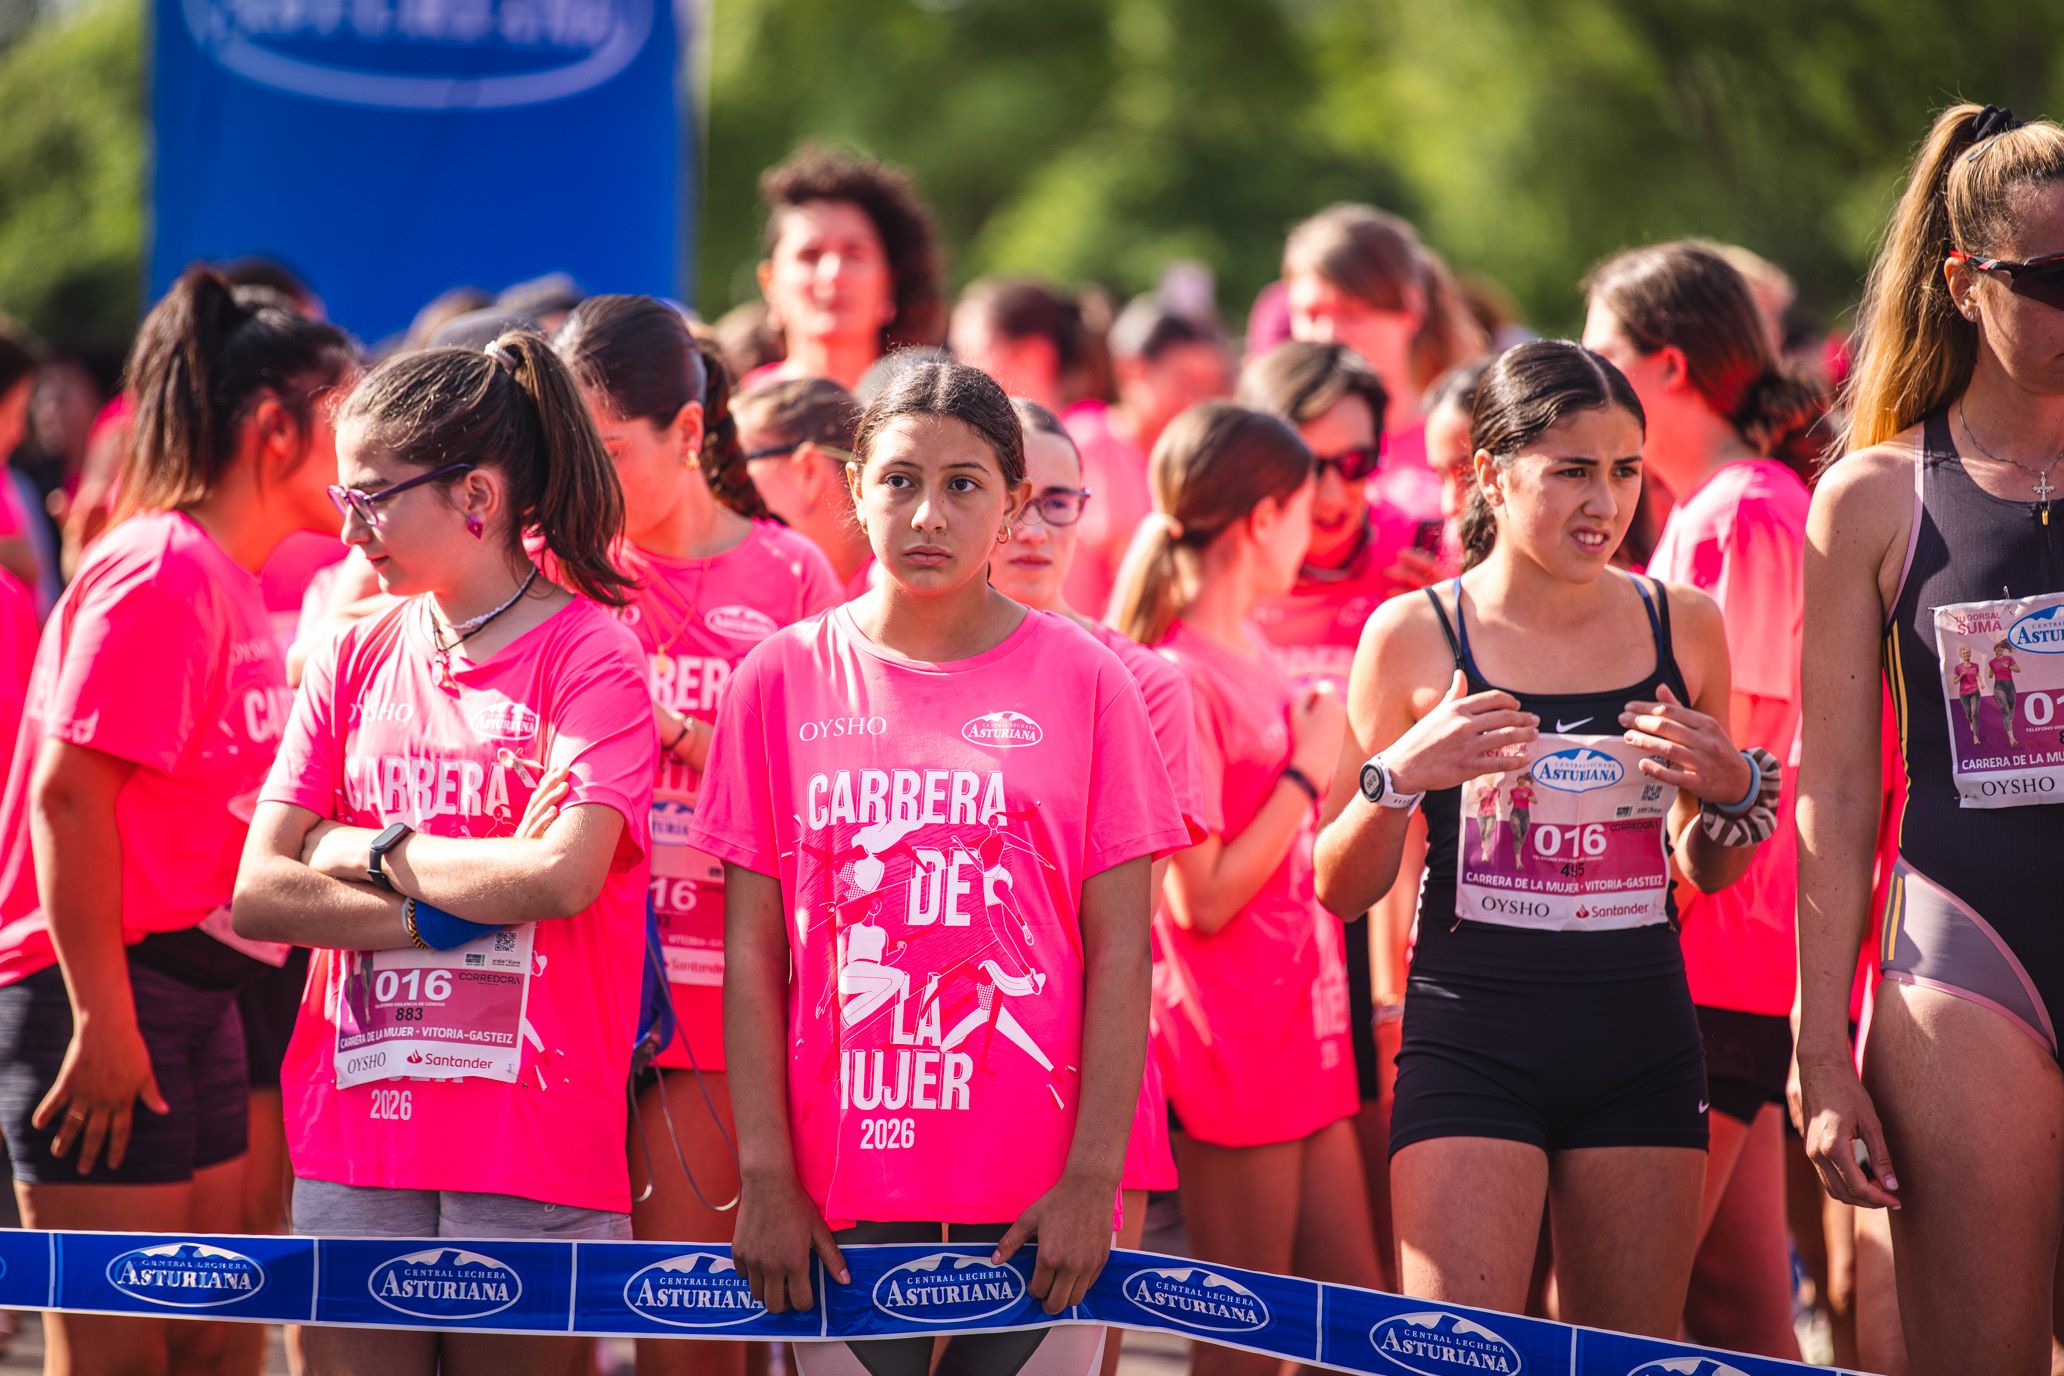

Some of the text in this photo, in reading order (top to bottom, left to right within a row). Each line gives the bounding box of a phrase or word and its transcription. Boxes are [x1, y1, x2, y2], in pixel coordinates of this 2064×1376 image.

[1967, 612, 2000, 621] DORSAL
[2032, 621, 2064, 629] CENTRA
[1957, 622, 2002, 635] SUMA
[2017, 626, 2064, 645] ASTU
[799, 716, 887, 741] OYSHO
[967, 723, 1036, 742] ASTURIANA
[1961, 752, 2064, 770] CARRERA DE LA MU
[345, 756, 511, 818] CARRERA
[1981, 776, 2055, 797] OYSHO
[807, 769, 1008, 831] CARRERA
[1534, 823, 1607, 858] 016
[1560, 863, 1585, 878] 495
[904, 846, 978, 926] DE
[1466, 872, 1663, 893] CARRERA DE LA MUJER VITORIA-GASTEIZ
[649, 877, 697, 911] 16
[1482, 895, 1550, 918] OYSHO
[1592, 903, 1650, 919] Santander
[374, 969, 453, 1003] 016
[459, 972, 521, 985] CORREDORA
[395, 1008, 423, 1021] 883
[891, 971, 942, 1047] LA
[340, 1027, 514, 1049] CARRERA DE LA MUJER VITORIA-GASTEIZ
[347, 1052, 386, 1074] OYSHO
[425, 1053, 493, 1070] Santander
[370, 1089, 412, 1120] 2026
[860, 1117, 915, 1150] 2026
[117, 1260, 253, 1290] ASTURIANA
[404, 1268, 506, 1280] CENTRAL LECHERA
[660, 1277, 750, 1287] CENTRAL LECHE
[907, 1271, 1008, 1285] CENTRAL LECHERA
[379, 1269, 510, 1302] ASTURIANA
[885, 1279, 1014, 1308] ASTURIANA
[1155, 1281, 1254, 1307] CENTRAL LECHERA
[1134, 1280, 1258, 1324] ASTURIANA
[1381, 1327, 1510, 1373] ASTURIANA
[1404, 1329, 1505, 1354] CENTRAL LECHERA
